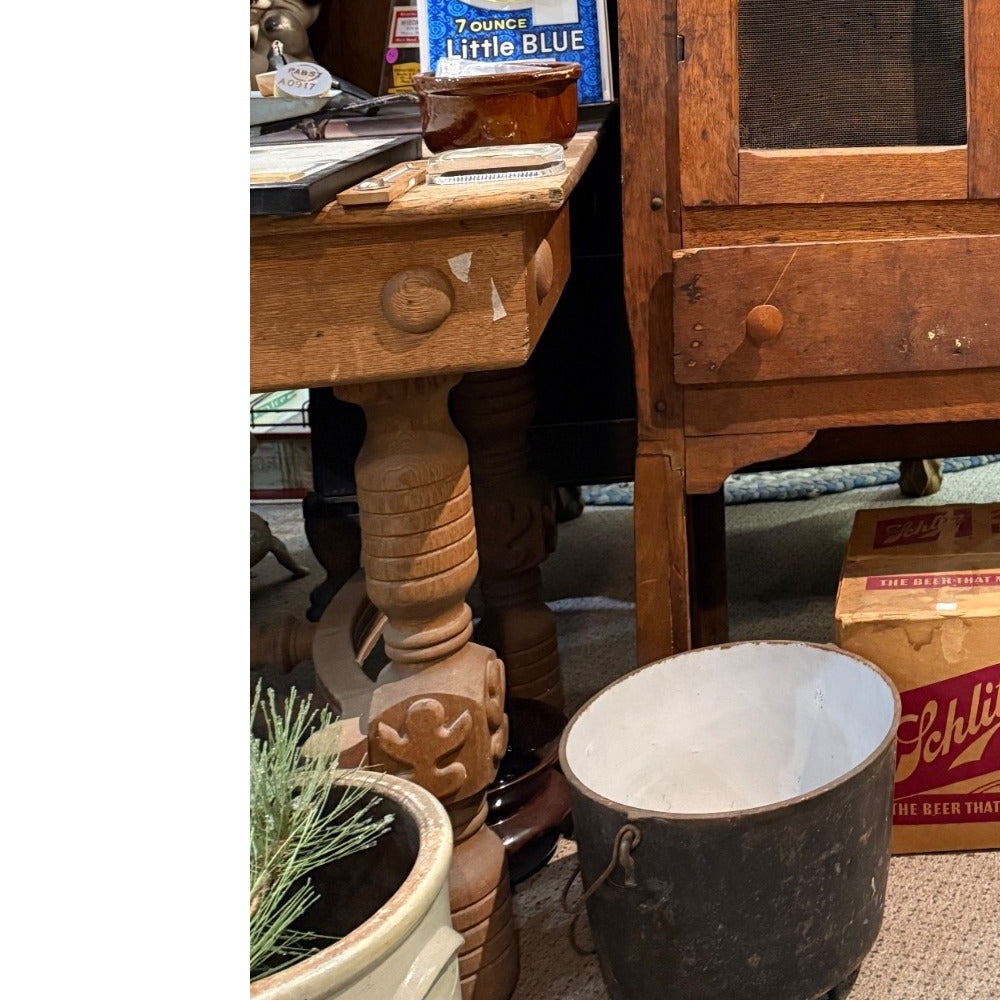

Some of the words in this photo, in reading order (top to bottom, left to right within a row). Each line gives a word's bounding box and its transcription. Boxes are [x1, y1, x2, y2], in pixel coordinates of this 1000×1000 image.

[455, 18, 467, 33] 7
[470, 18, 527, 32] OUNCE
[446, 35, 515, 59] Little
[522, 30, 585, 54] BLUE
[879, 578, 908, 587] THE
[913, 577, 951, 587] BEER
[956, 575, 992, 586] THAT
[923, 801, 961, 816] BEER
[965, 799, 1000, 814] THAT
